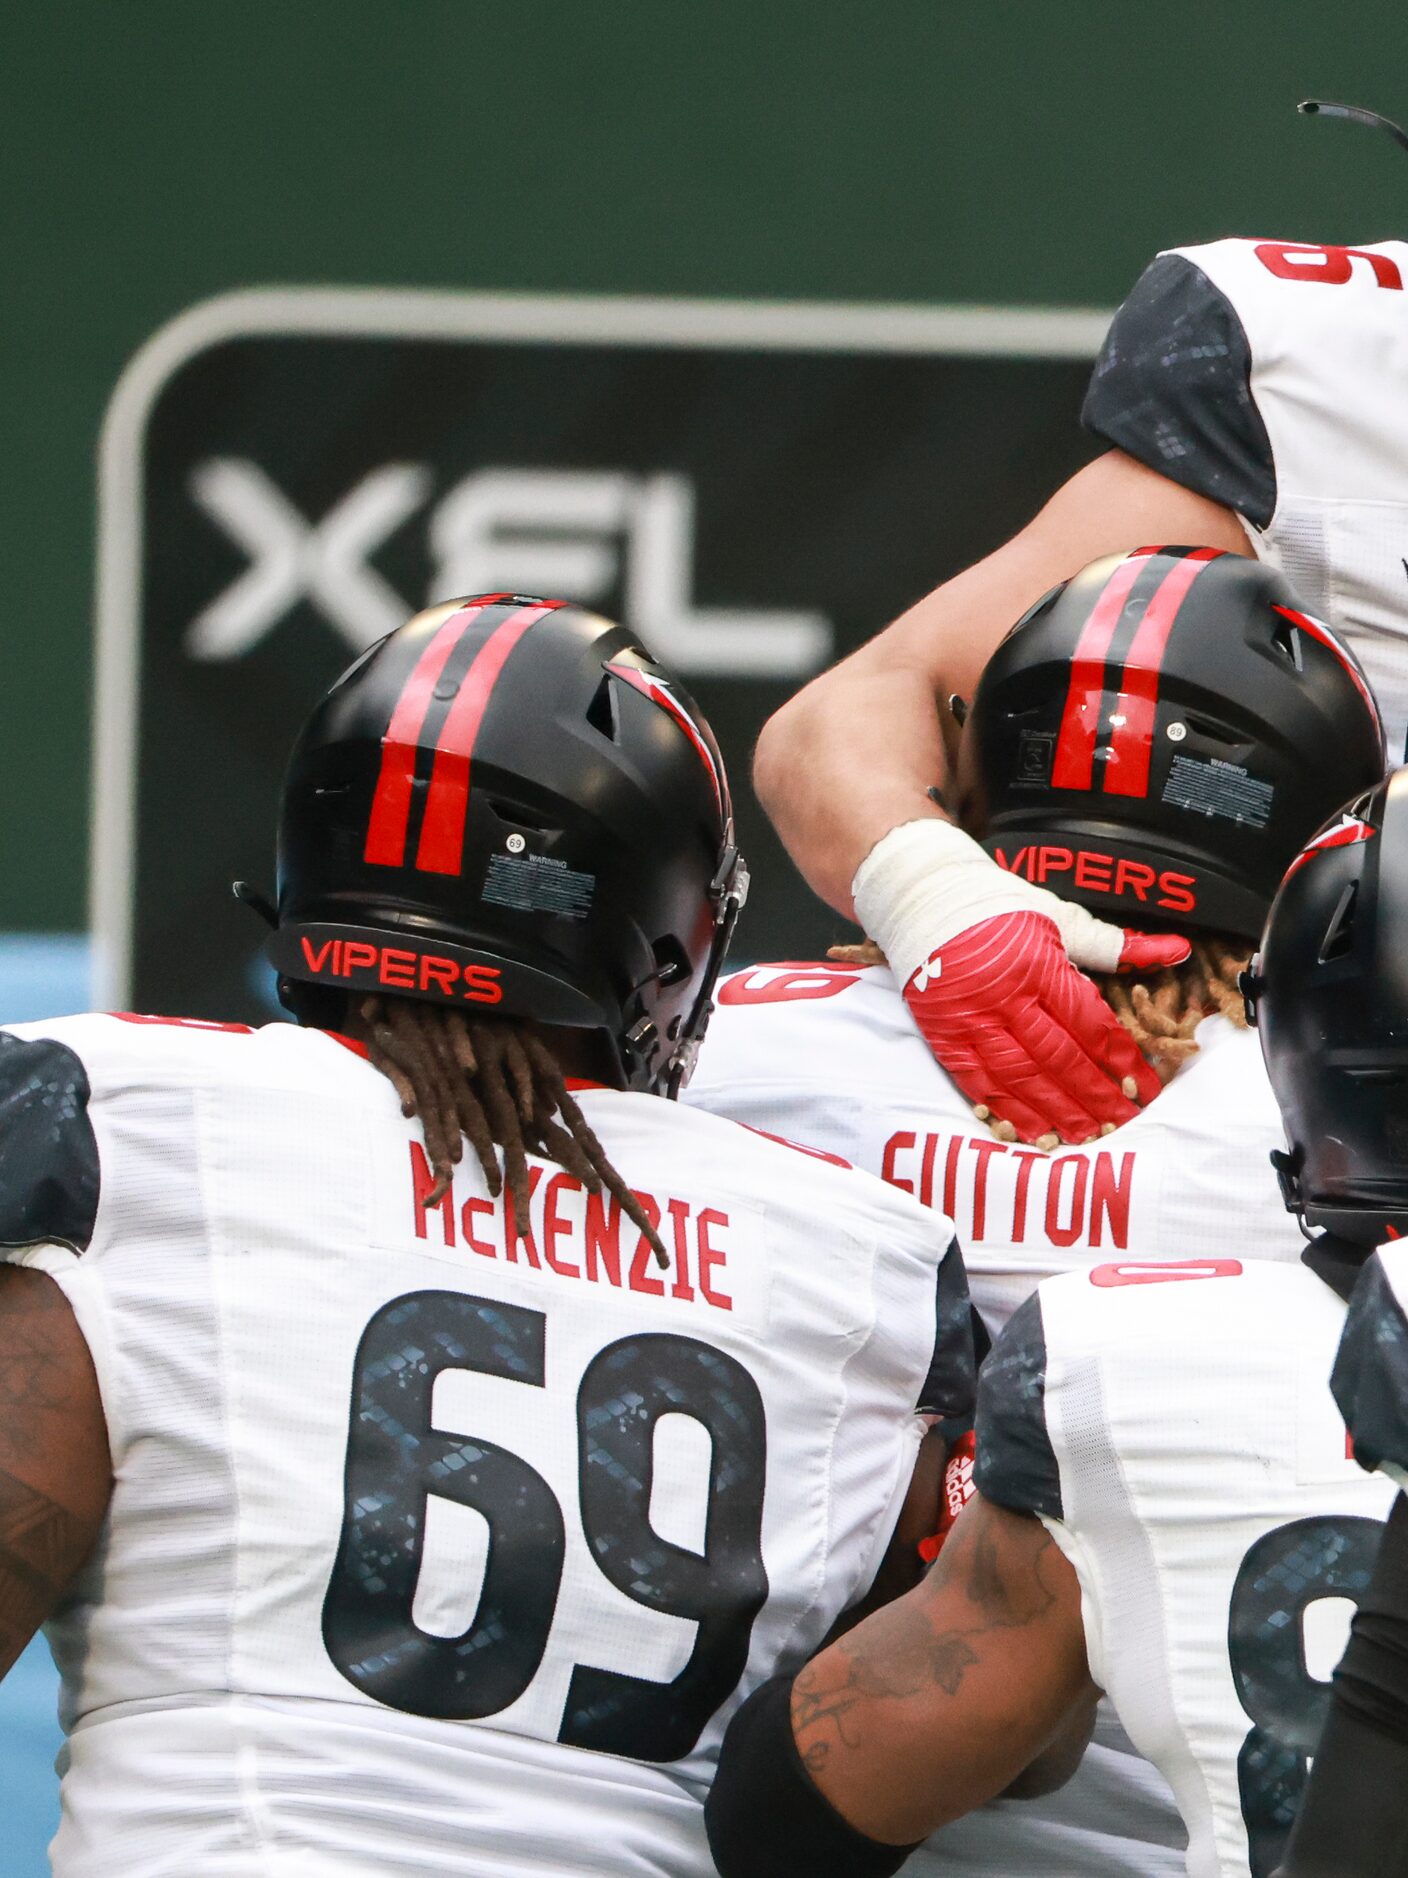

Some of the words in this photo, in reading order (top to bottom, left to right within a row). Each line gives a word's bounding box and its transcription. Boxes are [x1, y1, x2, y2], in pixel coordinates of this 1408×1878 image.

[186, 456, 836, 678] XFL
[994, 845, 1196, 913] VIPERS
[301, 936, 503, 1005] VIPERS
[409, 1139, 733, 1312] McKENZIE
[321, 1289, 770, 1763] 69
